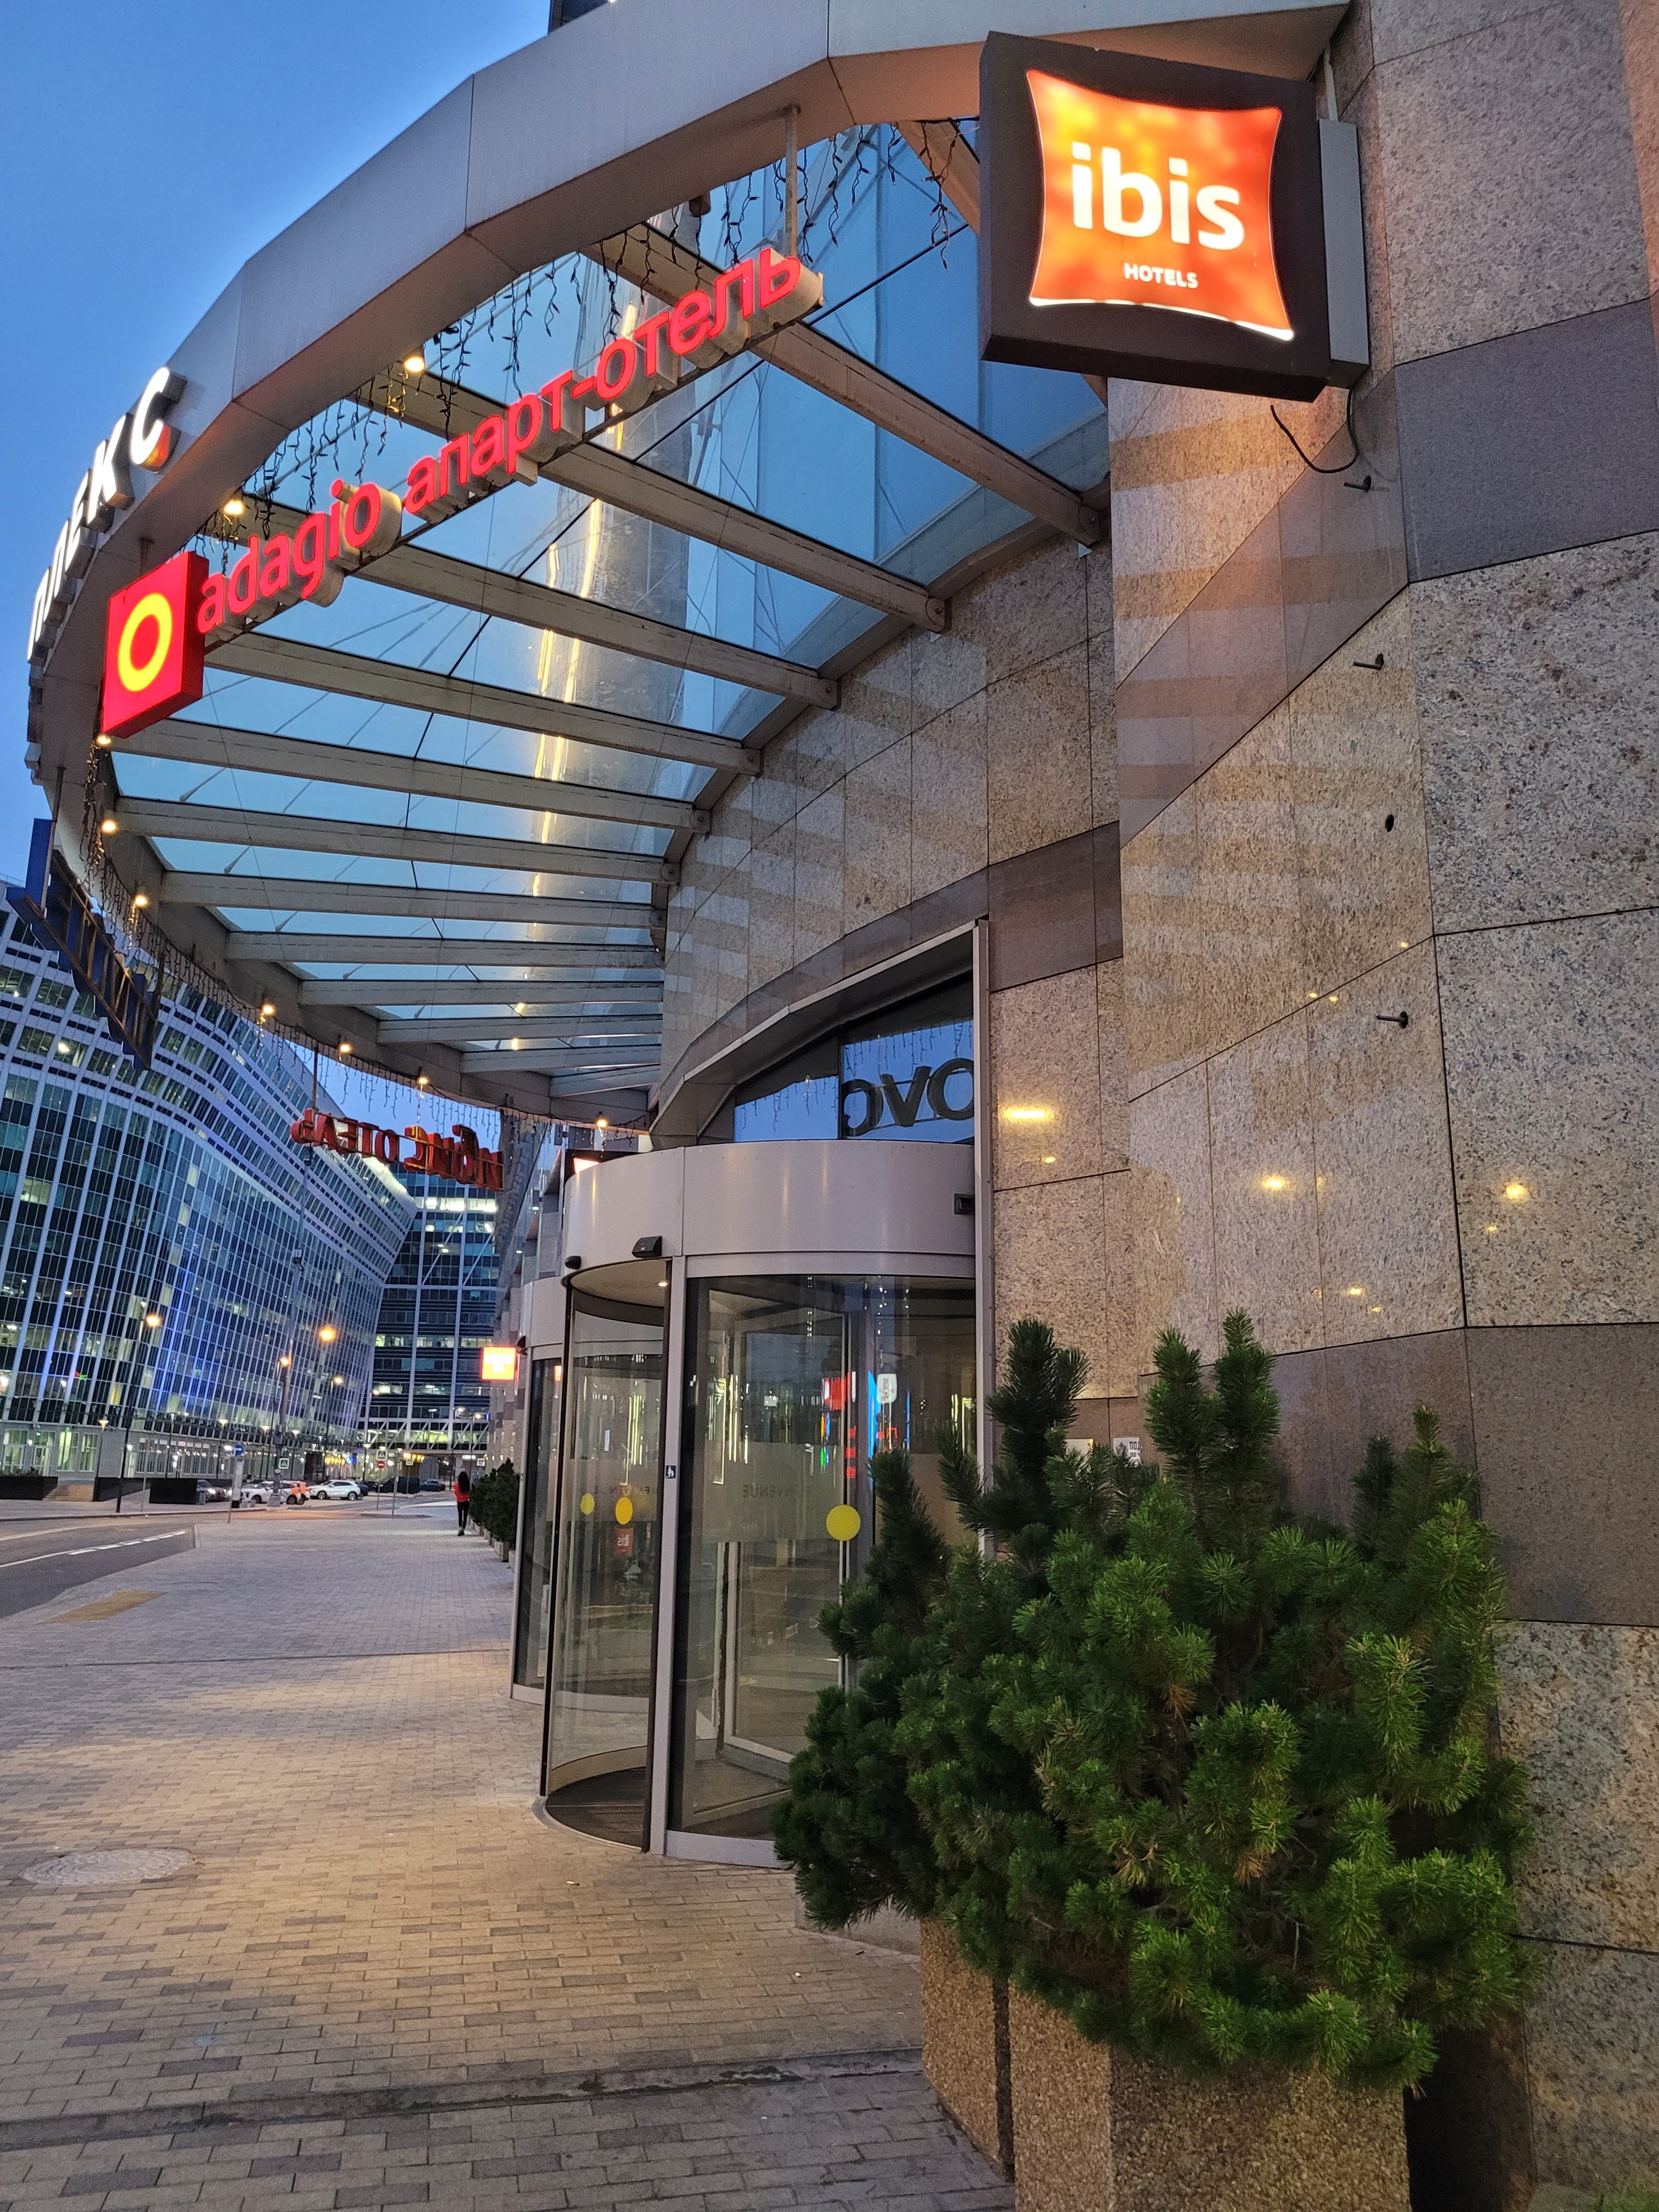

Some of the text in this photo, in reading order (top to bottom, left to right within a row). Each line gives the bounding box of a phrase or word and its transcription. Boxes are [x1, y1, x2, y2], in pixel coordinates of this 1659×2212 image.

[1071, 141, 1245, 251] ibis
[1124, 262, 1198, 290] HOTELS
[196, 255, 802, 635] adagio апарт-отель
